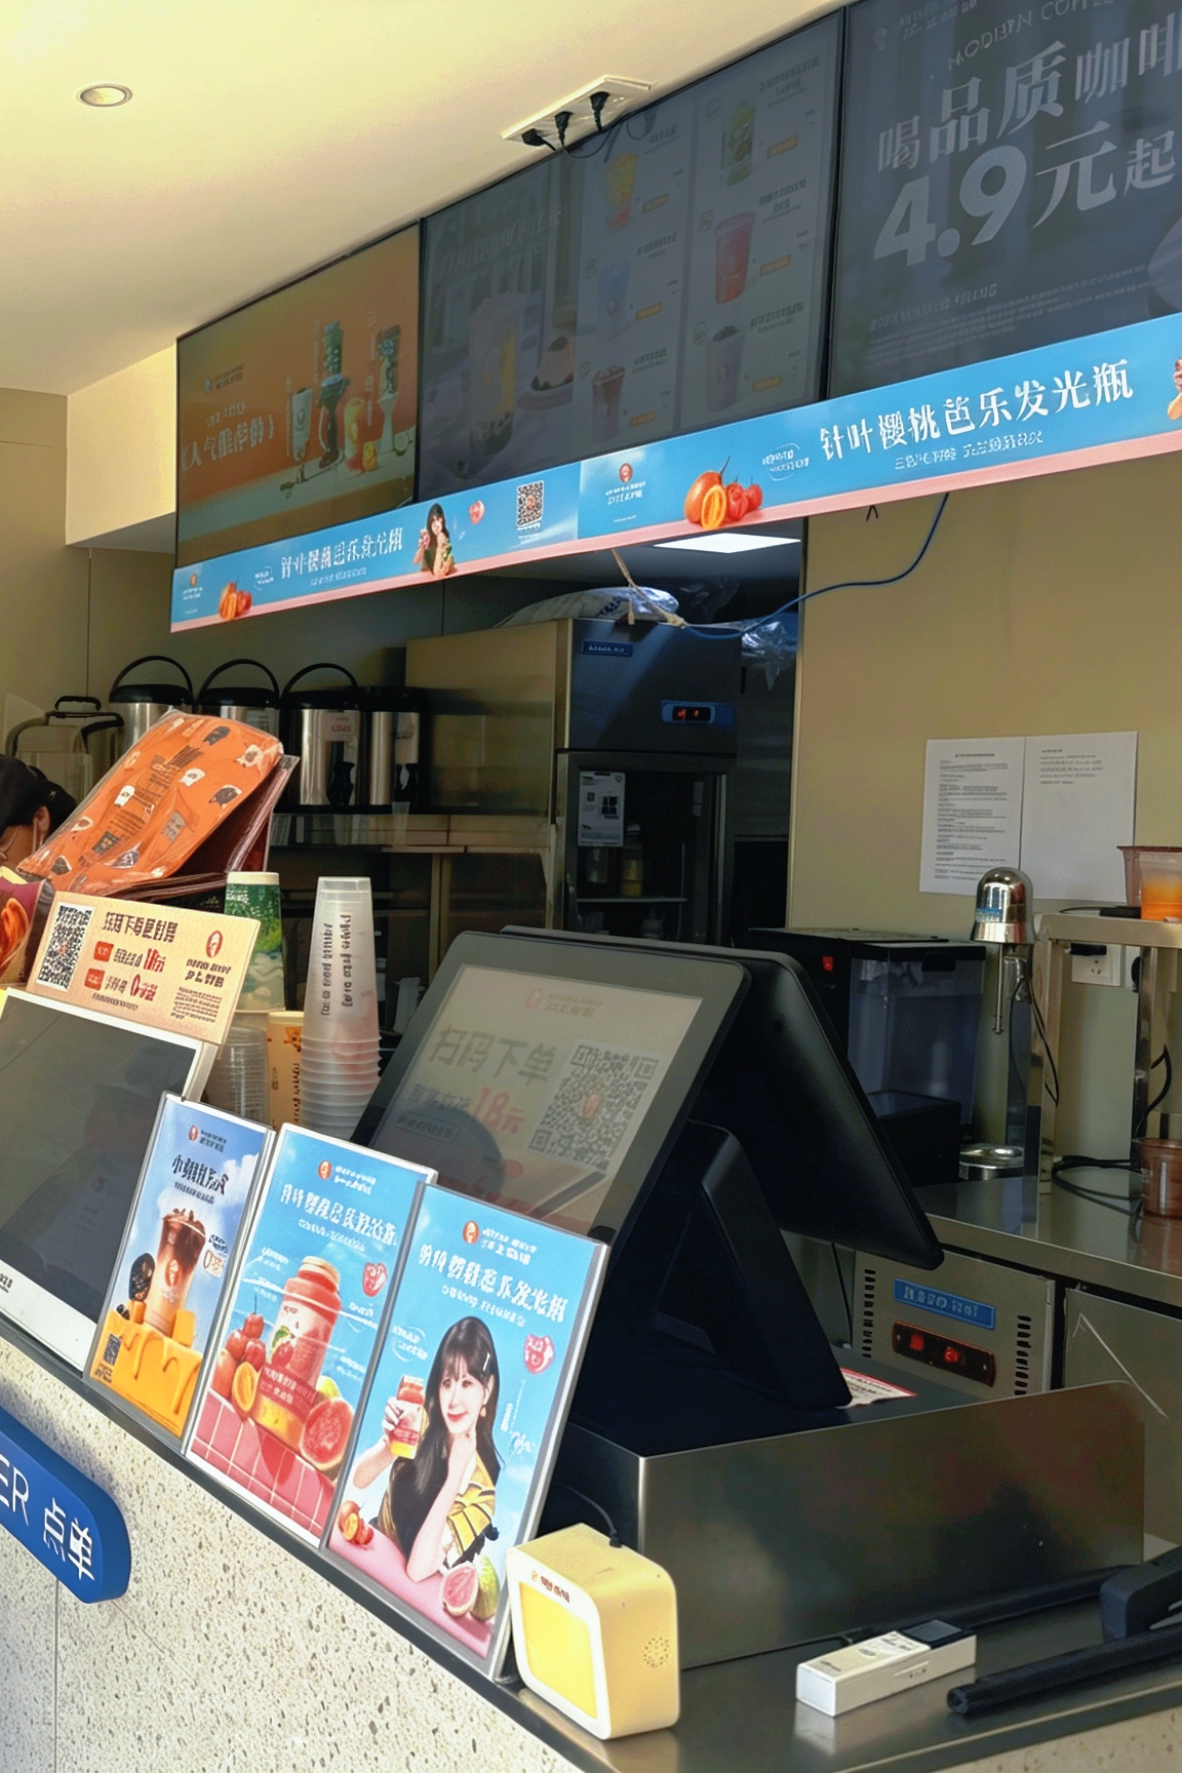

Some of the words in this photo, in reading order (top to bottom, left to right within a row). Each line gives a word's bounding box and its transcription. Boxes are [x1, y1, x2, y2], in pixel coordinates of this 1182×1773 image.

[873, 120, 1176, 267] 4.9元起
[820, 358, 1134, 461] 针叶樱桃芭乐发光瓶
